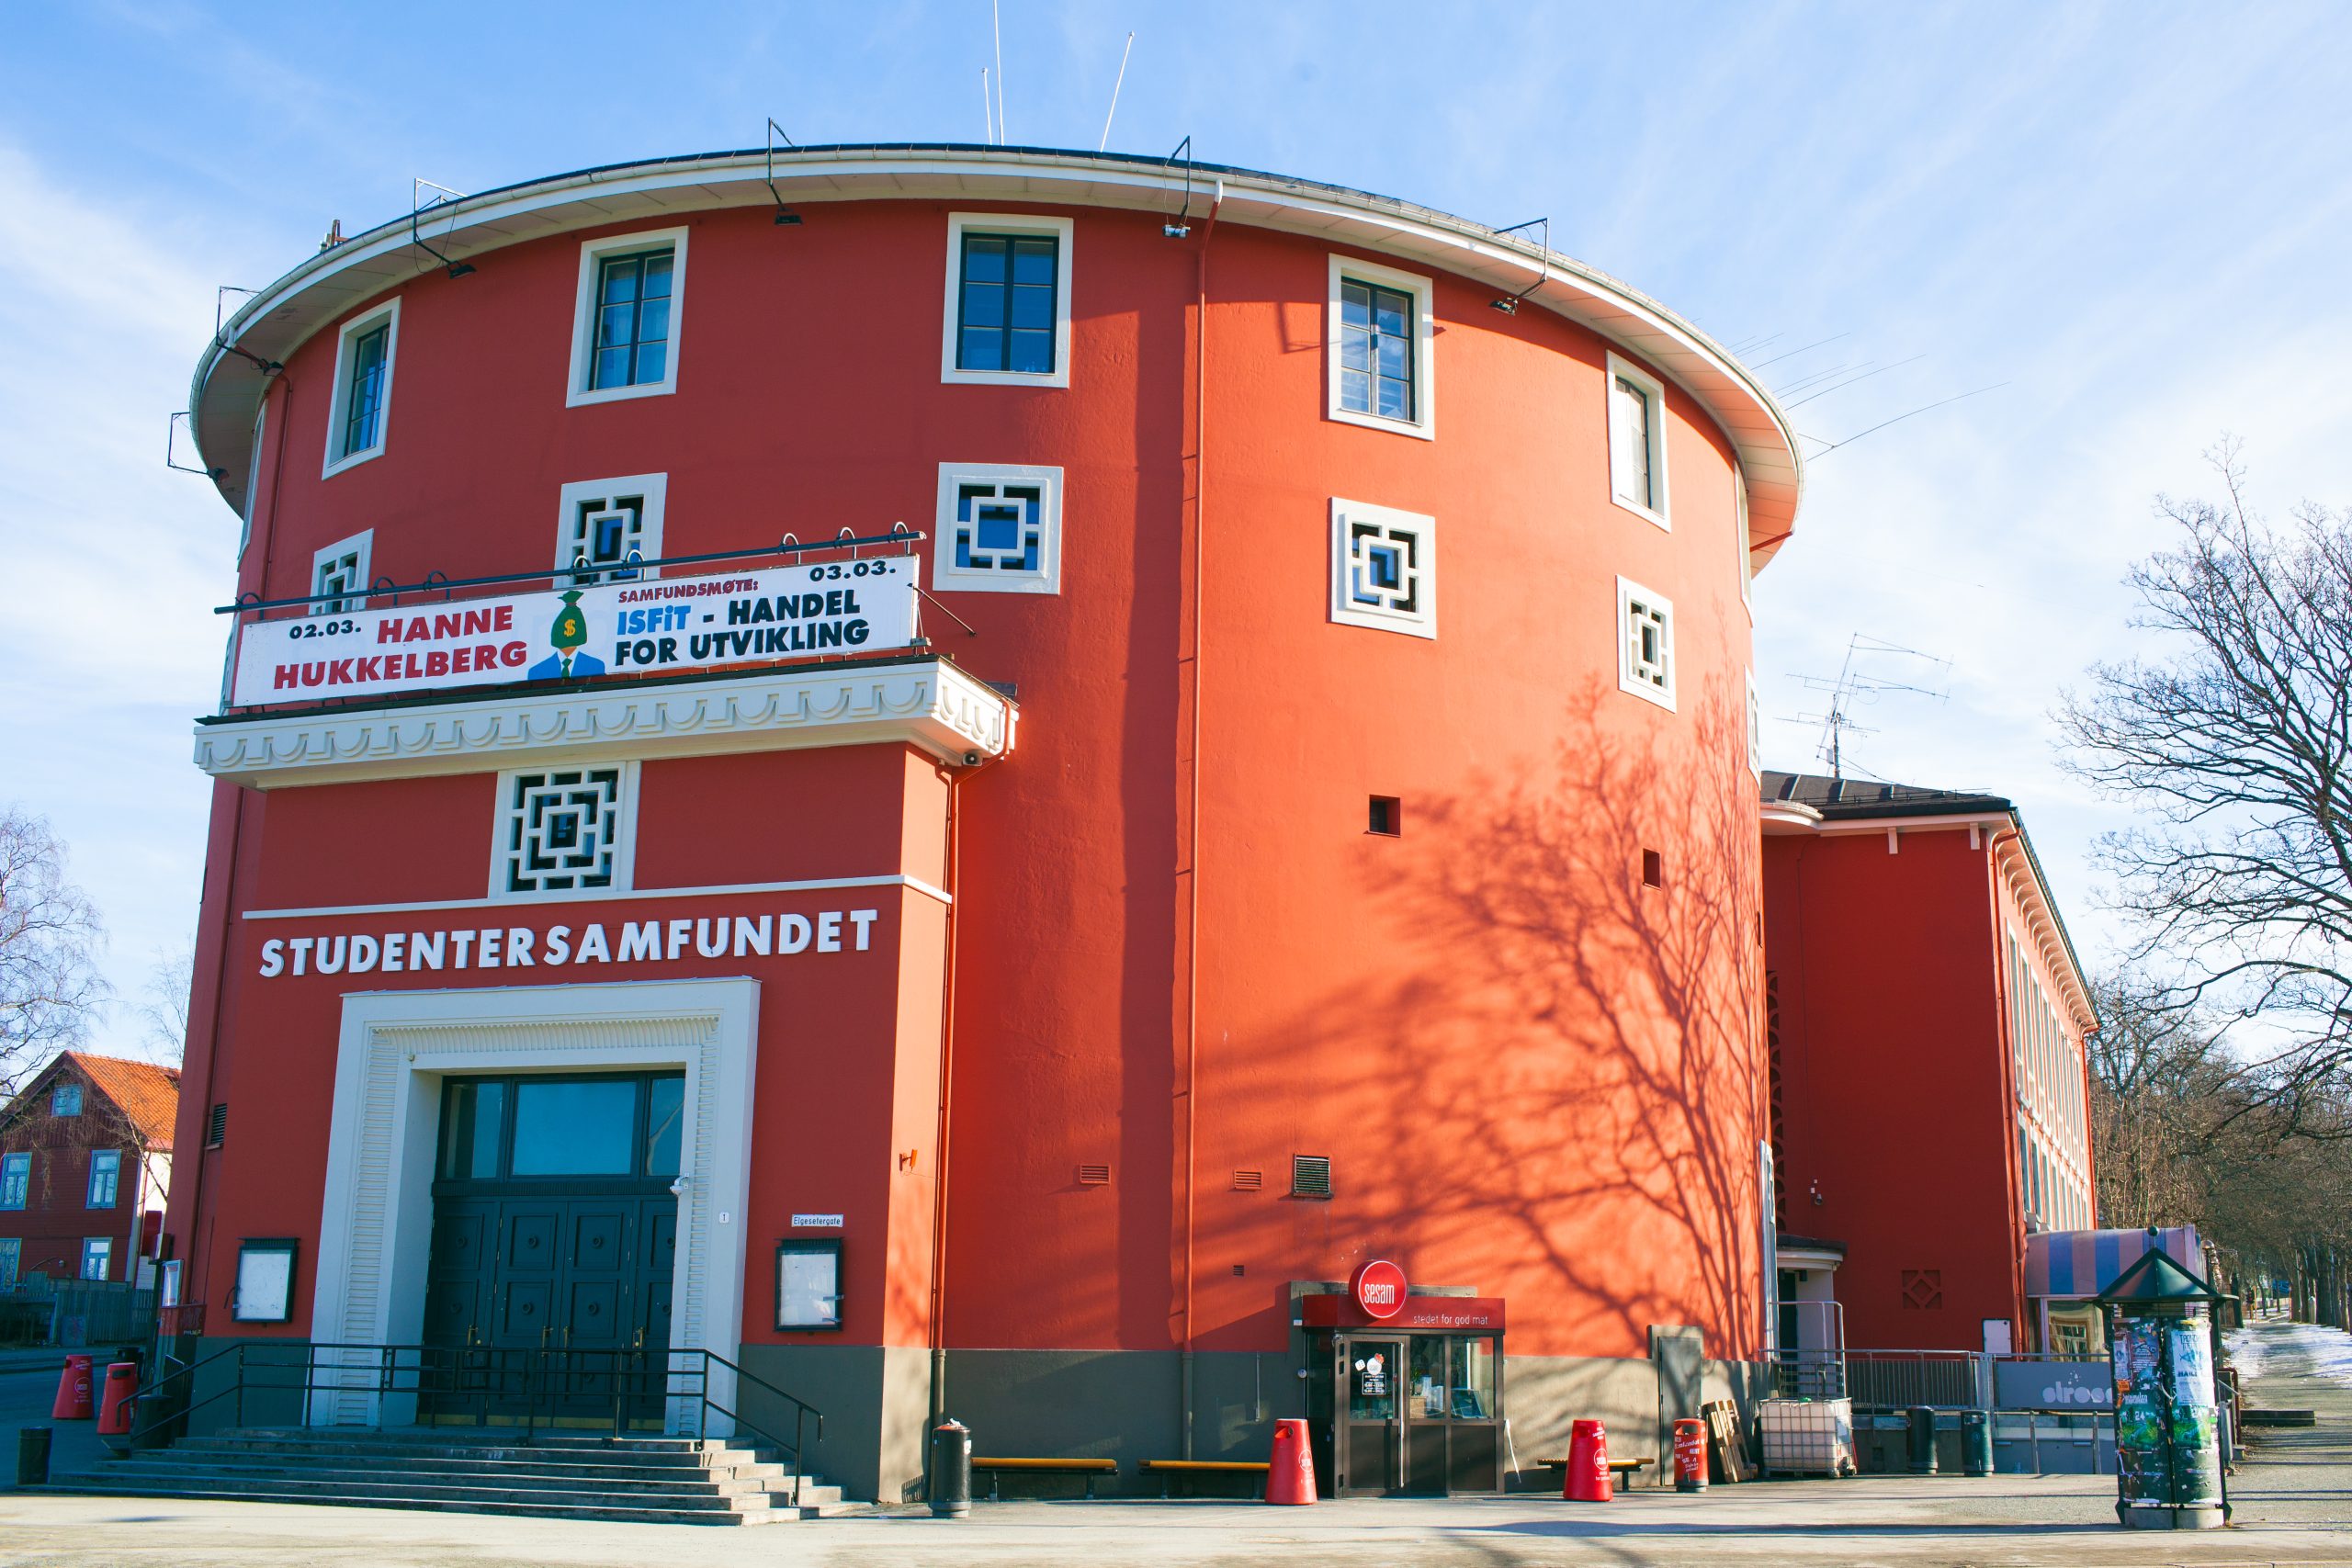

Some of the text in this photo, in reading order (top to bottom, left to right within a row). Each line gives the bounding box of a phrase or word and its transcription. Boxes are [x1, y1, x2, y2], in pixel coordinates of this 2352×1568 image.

[808, 560, 897, 582] 03.03.
[617, 579, 759, 604] SAMFUNDSMØTE:
[377, 604, 514, 645] HANNE
[616, 604, 691, 636] ISFiT
[728, 589, 862, 626] HANDEL
[288, 619, 362, 639] 02.03.
[615, 618, 870, 667] FOR UTVIKLING
[274, 640, 527, 690] HUKKELBERG
[258, 908, 879, 978] STUDENTERSAMFUNDET
[793, 1216, 841, 1225] Elgesetergate
[1364, 1283, 1395, 1305] sesam
[1413, 1314, 1488, 1327] stedet for god mat
